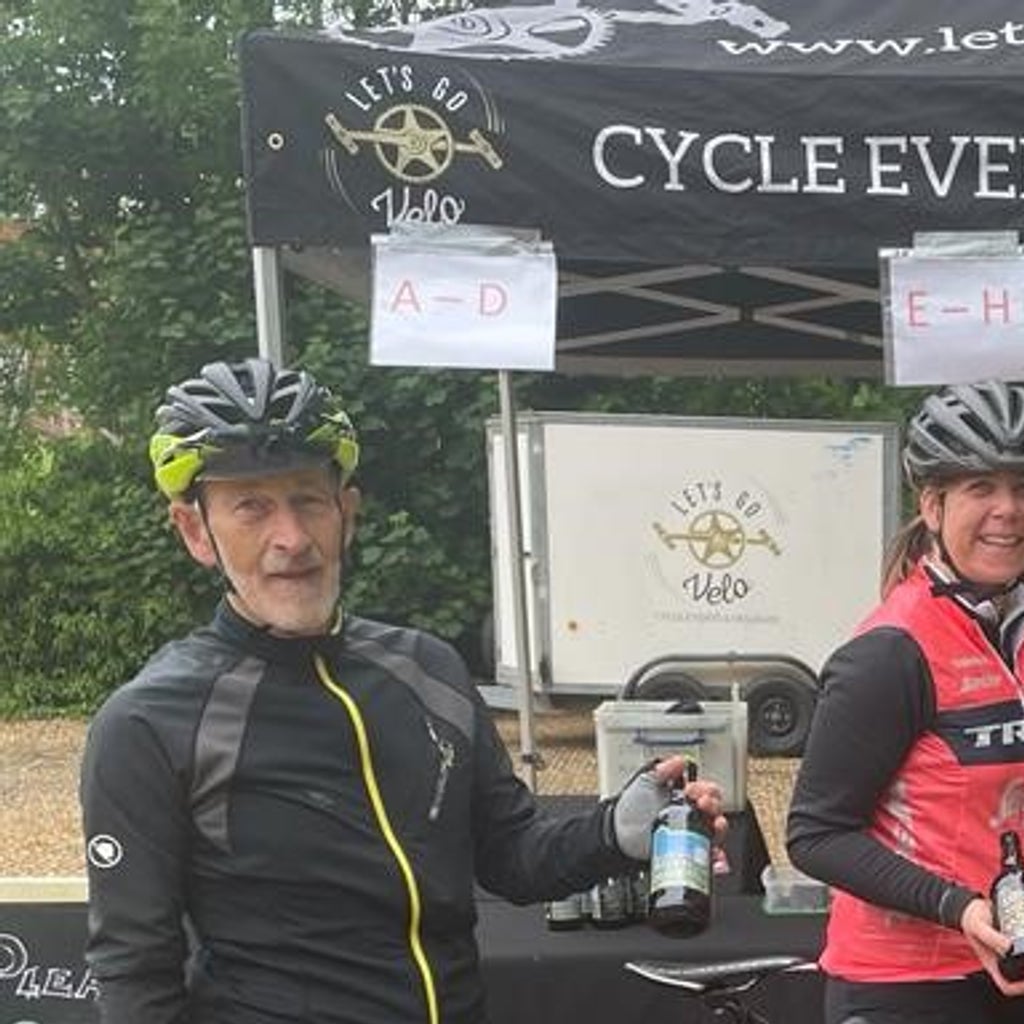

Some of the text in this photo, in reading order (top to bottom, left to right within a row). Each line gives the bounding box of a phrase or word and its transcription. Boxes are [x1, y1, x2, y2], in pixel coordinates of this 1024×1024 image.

[344, 64, 469, 112] LET'S GO
[592, 125, 847, 193] CYCLE
[370, 186, 466, 228] Velo
[670, 481, 762, 519] LET'S GO
[682, 573, 749, 606] Velo
